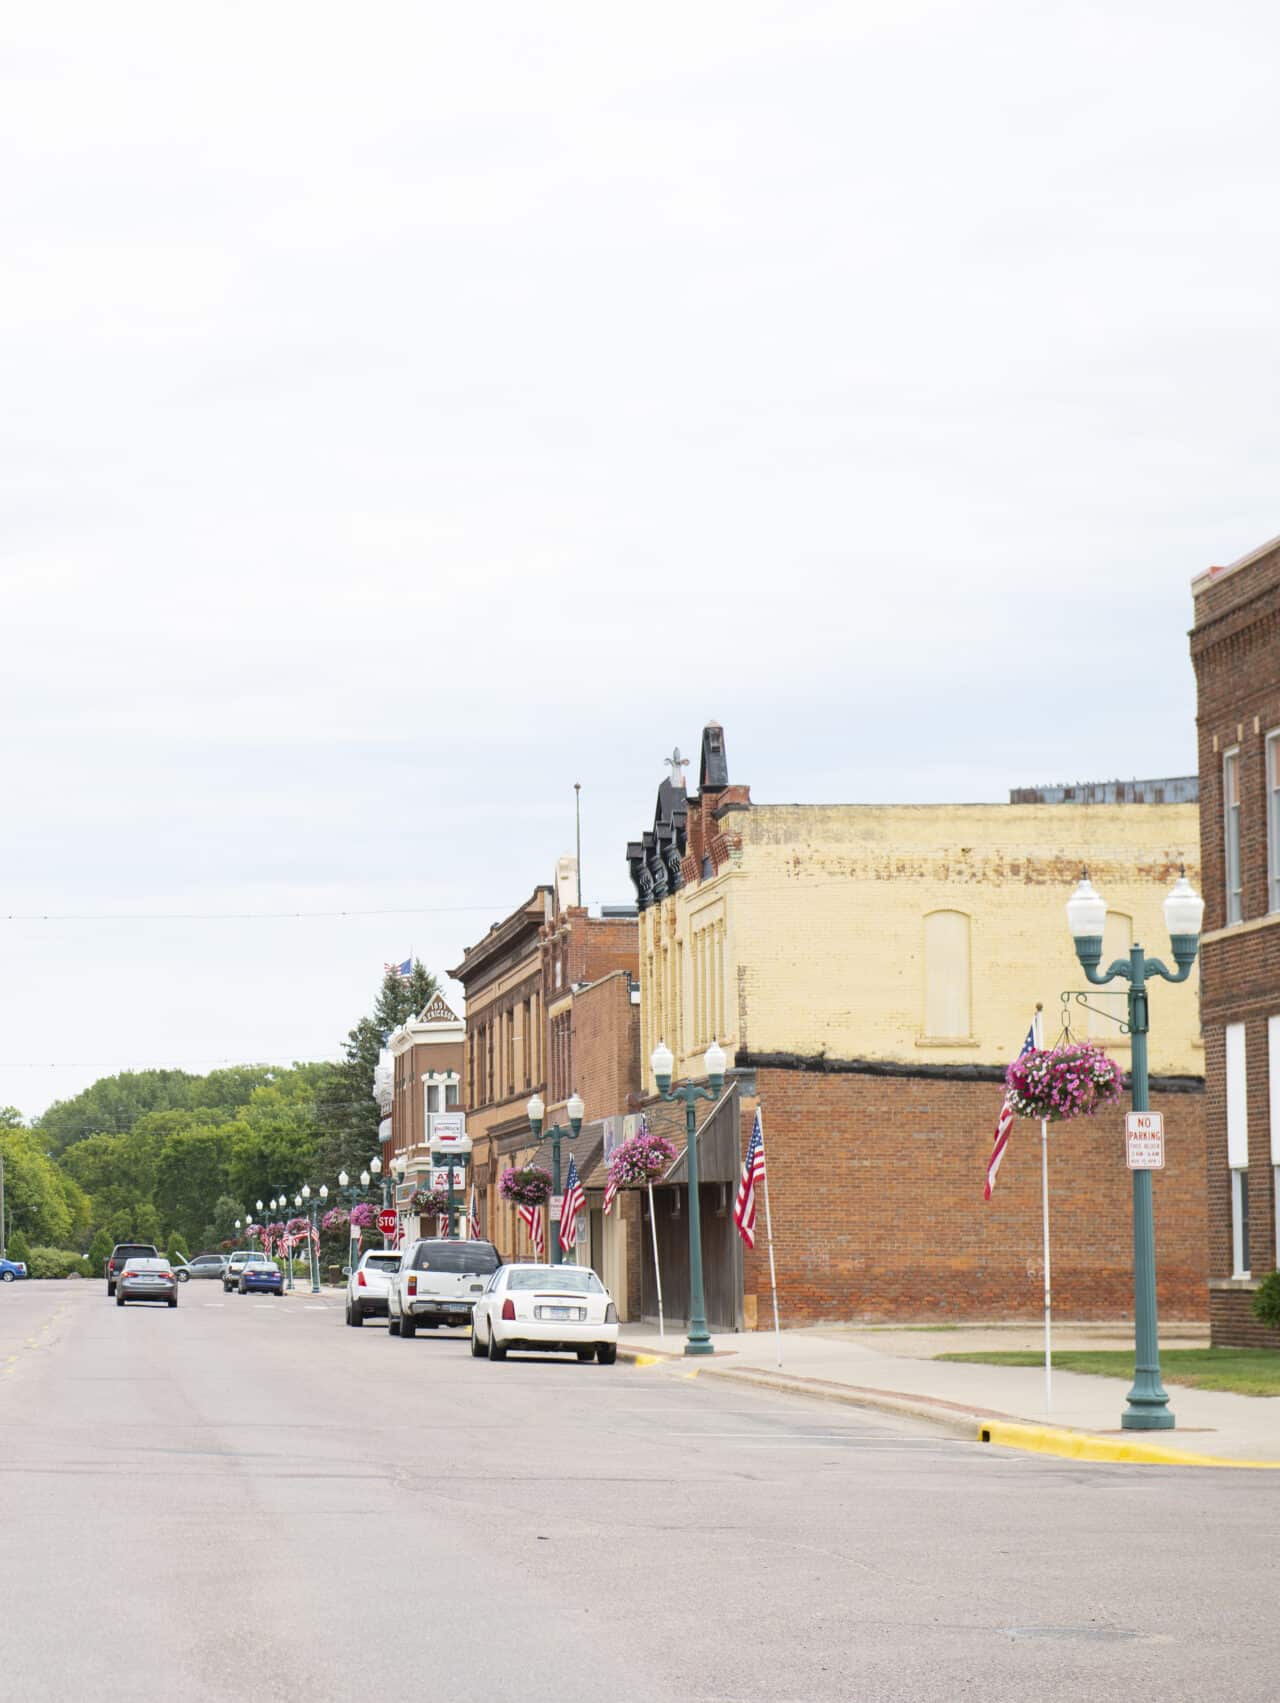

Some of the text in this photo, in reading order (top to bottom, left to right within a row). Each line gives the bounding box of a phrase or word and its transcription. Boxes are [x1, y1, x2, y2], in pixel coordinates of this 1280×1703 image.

[1138, 1117, 1151, 1128] NO
[1128, 1131, 1160, 1140] PARKING
[379, 1216, 395, 1227] STO
